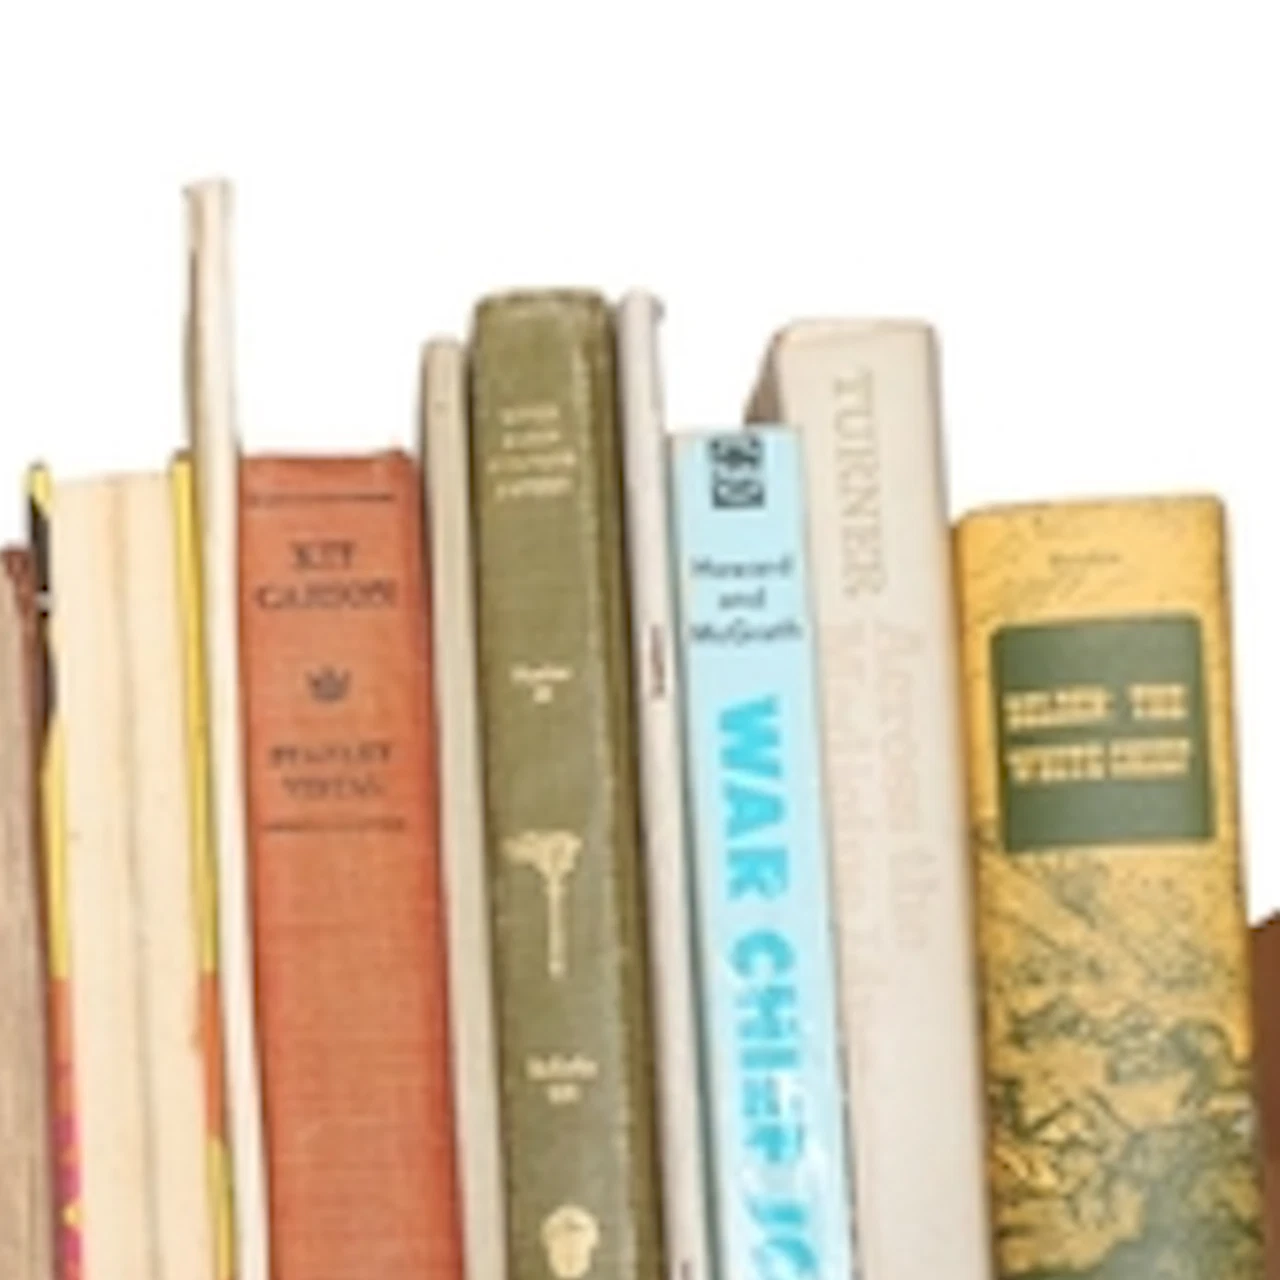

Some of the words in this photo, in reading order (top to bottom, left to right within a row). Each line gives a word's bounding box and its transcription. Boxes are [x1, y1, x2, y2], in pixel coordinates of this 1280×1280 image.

[833, 366, 888, 602] TURNER
[289, 539, 358, 570] KIT
[690, 554, 794, 581] Howard
[254, 579, 398, 611] CARSON
[718, 586, 767, 611] and
[689, 618, 803, 648] McGrath
[716, 692, 791, 902] WAR
[887, 850, 942, 951] the
